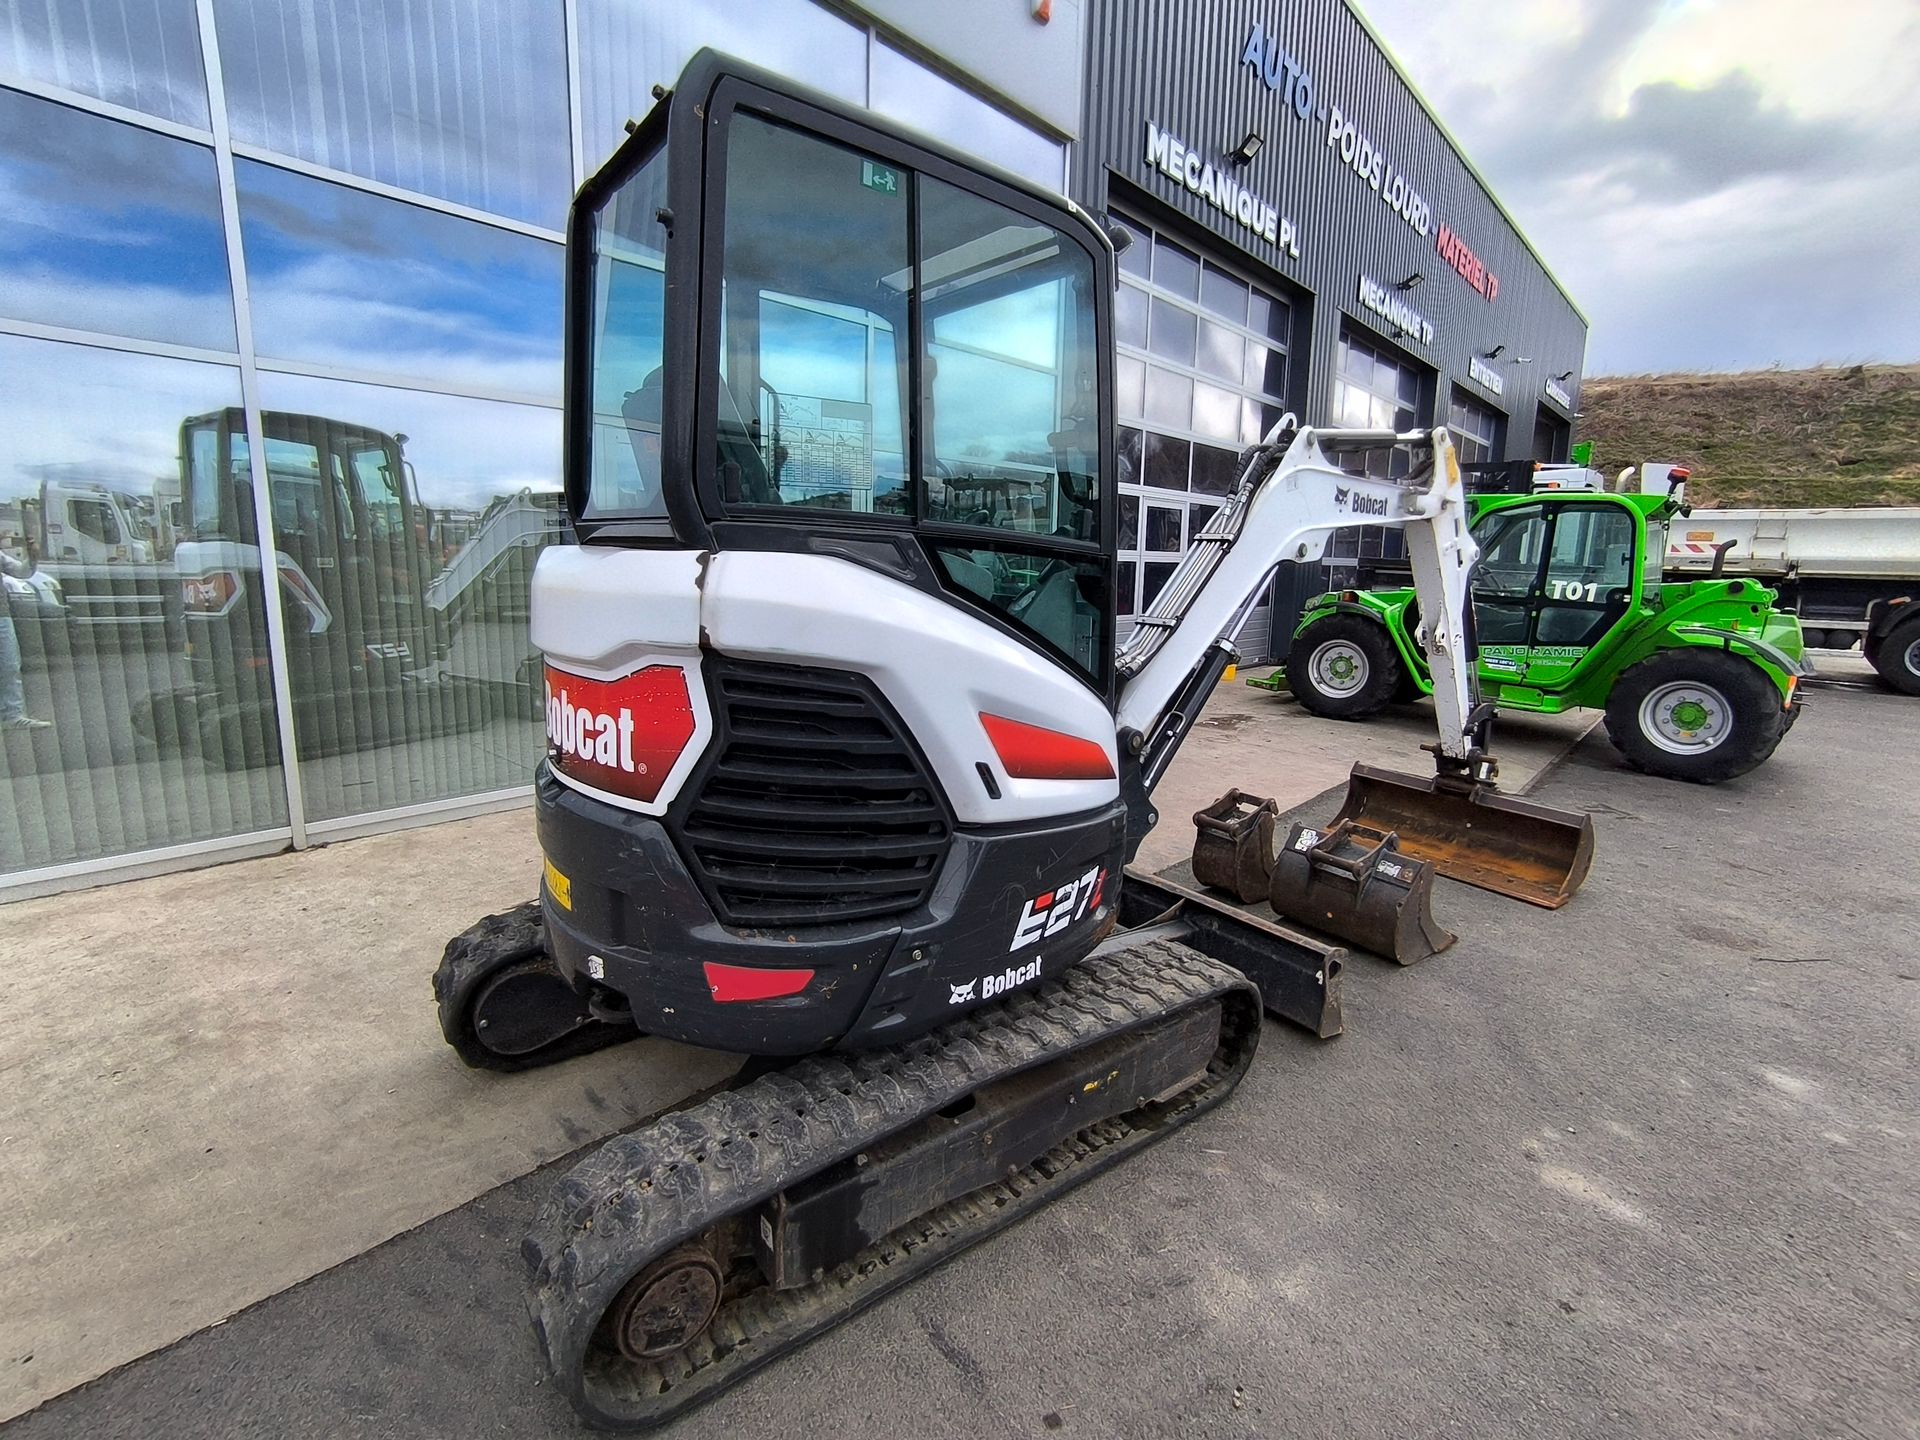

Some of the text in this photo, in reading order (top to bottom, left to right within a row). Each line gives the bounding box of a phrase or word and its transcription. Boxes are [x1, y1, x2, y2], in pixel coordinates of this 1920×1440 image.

[1145, 121, 1300, 260] MECANIQUE PL
[1241, 21, 1313, 120] AUTO
[1327, 105, 1382, 190] POIDS
[1382, 164, 1430, 238] LOURD
[1437, 221, 1485, 296] MATERIEL
[1486, 271, 1500, 303] TP
[1358, 275, 1433, 346] MECANIQUE TP
[1352, 491, 1388, 516] Bobcat
[1551, 580, 1598, 603] T01
[545, 679, 635, 773] Bobcat
[982, 955, 1043, 1000] Bobcat
